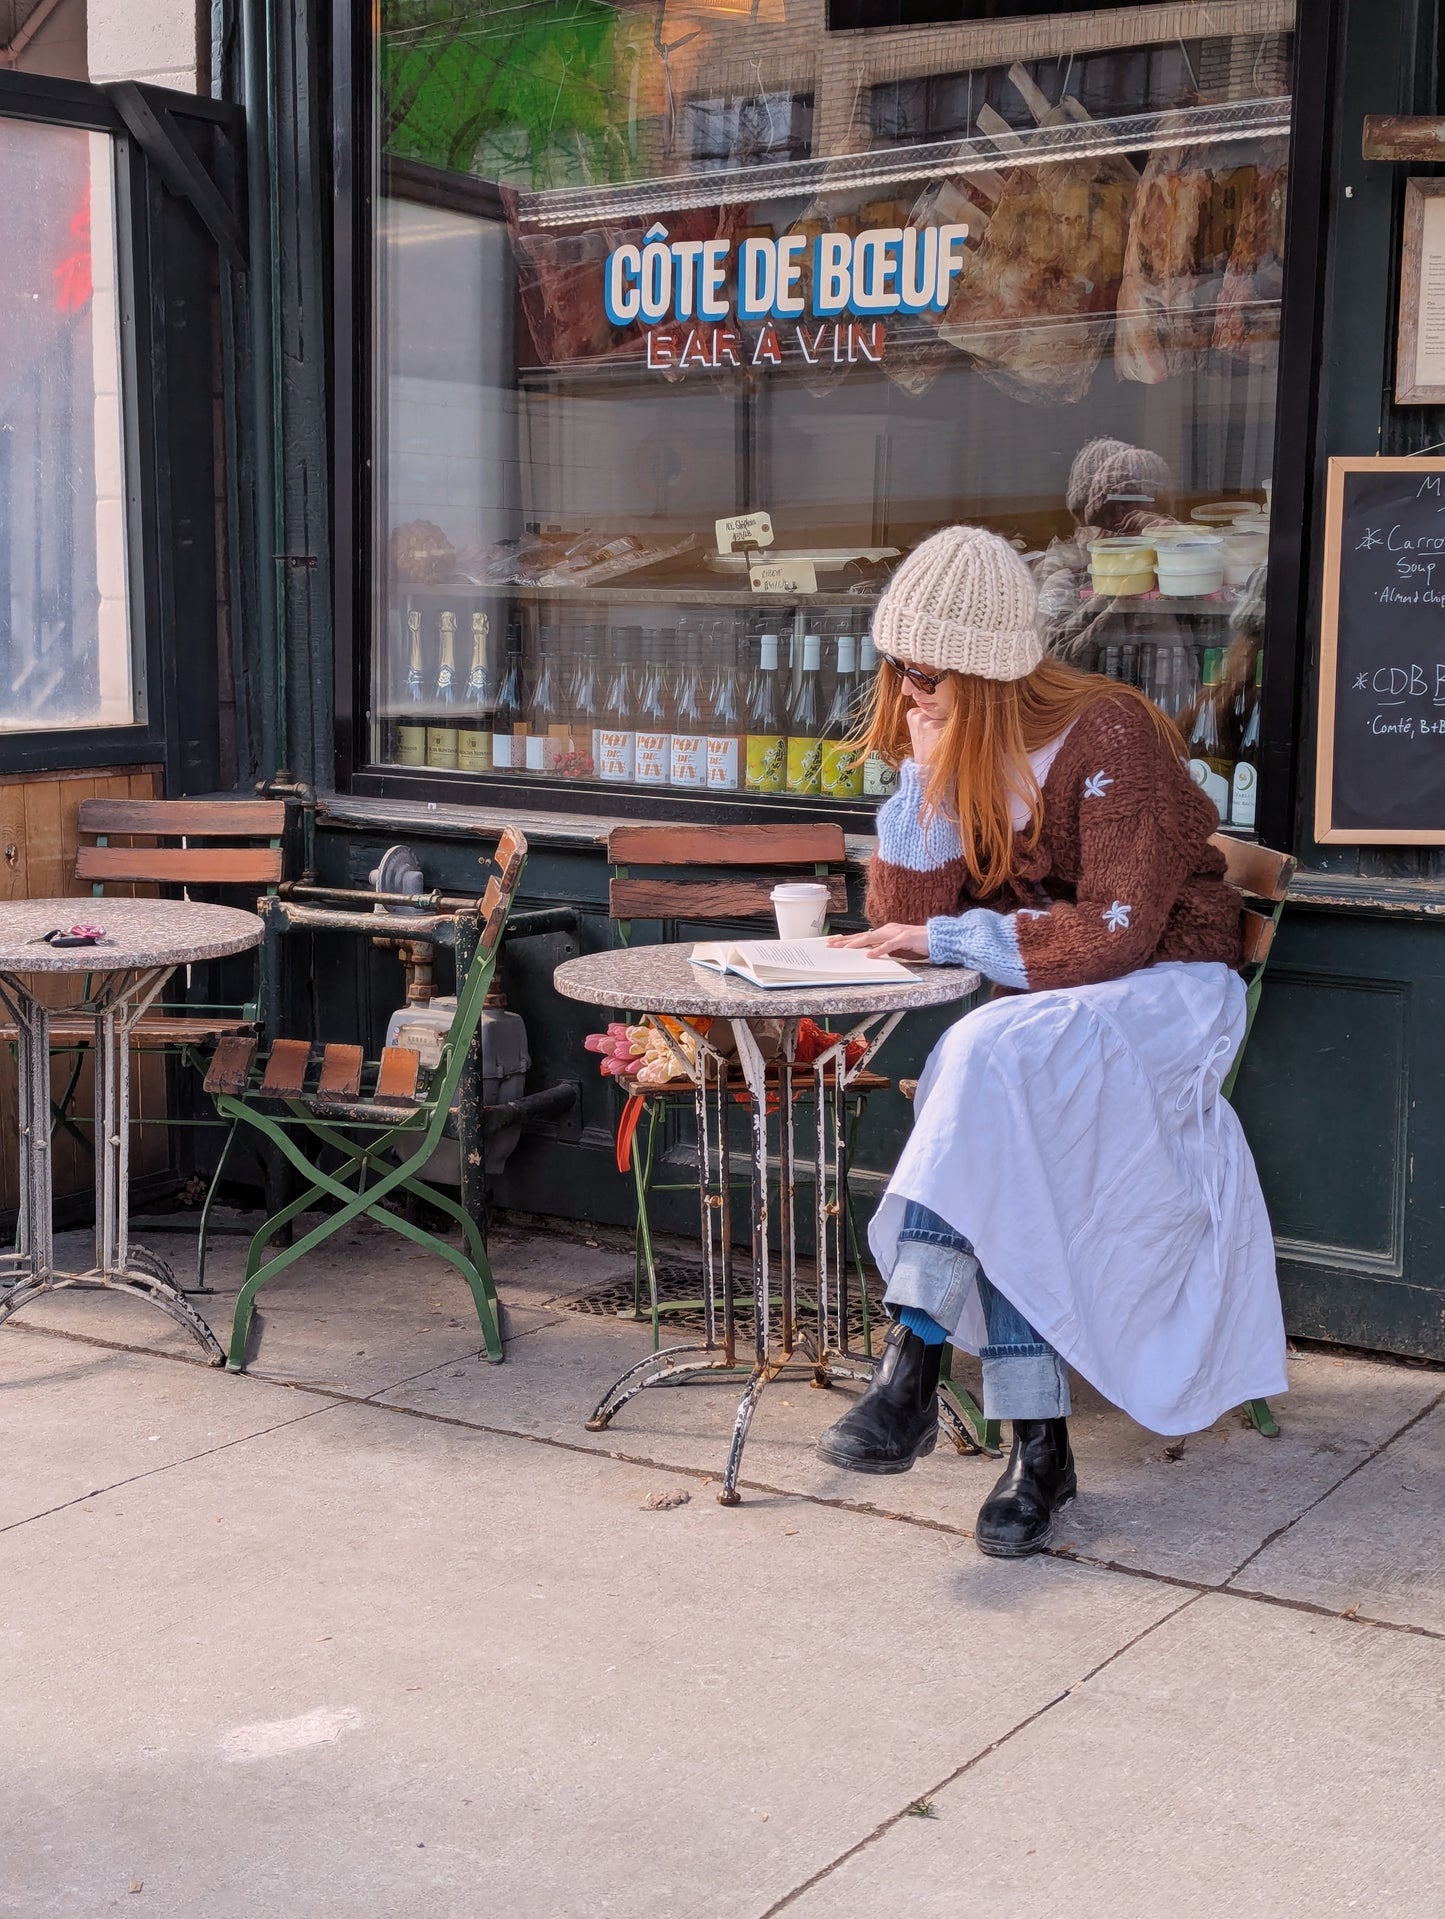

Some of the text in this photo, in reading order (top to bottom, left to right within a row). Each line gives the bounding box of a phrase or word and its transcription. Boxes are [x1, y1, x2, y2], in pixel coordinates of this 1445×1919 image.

[605, 221, 969, 326] CÔTE DE BŒUF
[647, 321, 886, 369] BAR À VIN
[1396, 556, 1436, 586] Soup
[1372, 663, 1428, 696] CDB
[1372, 714, 1415, 740] Comté,
